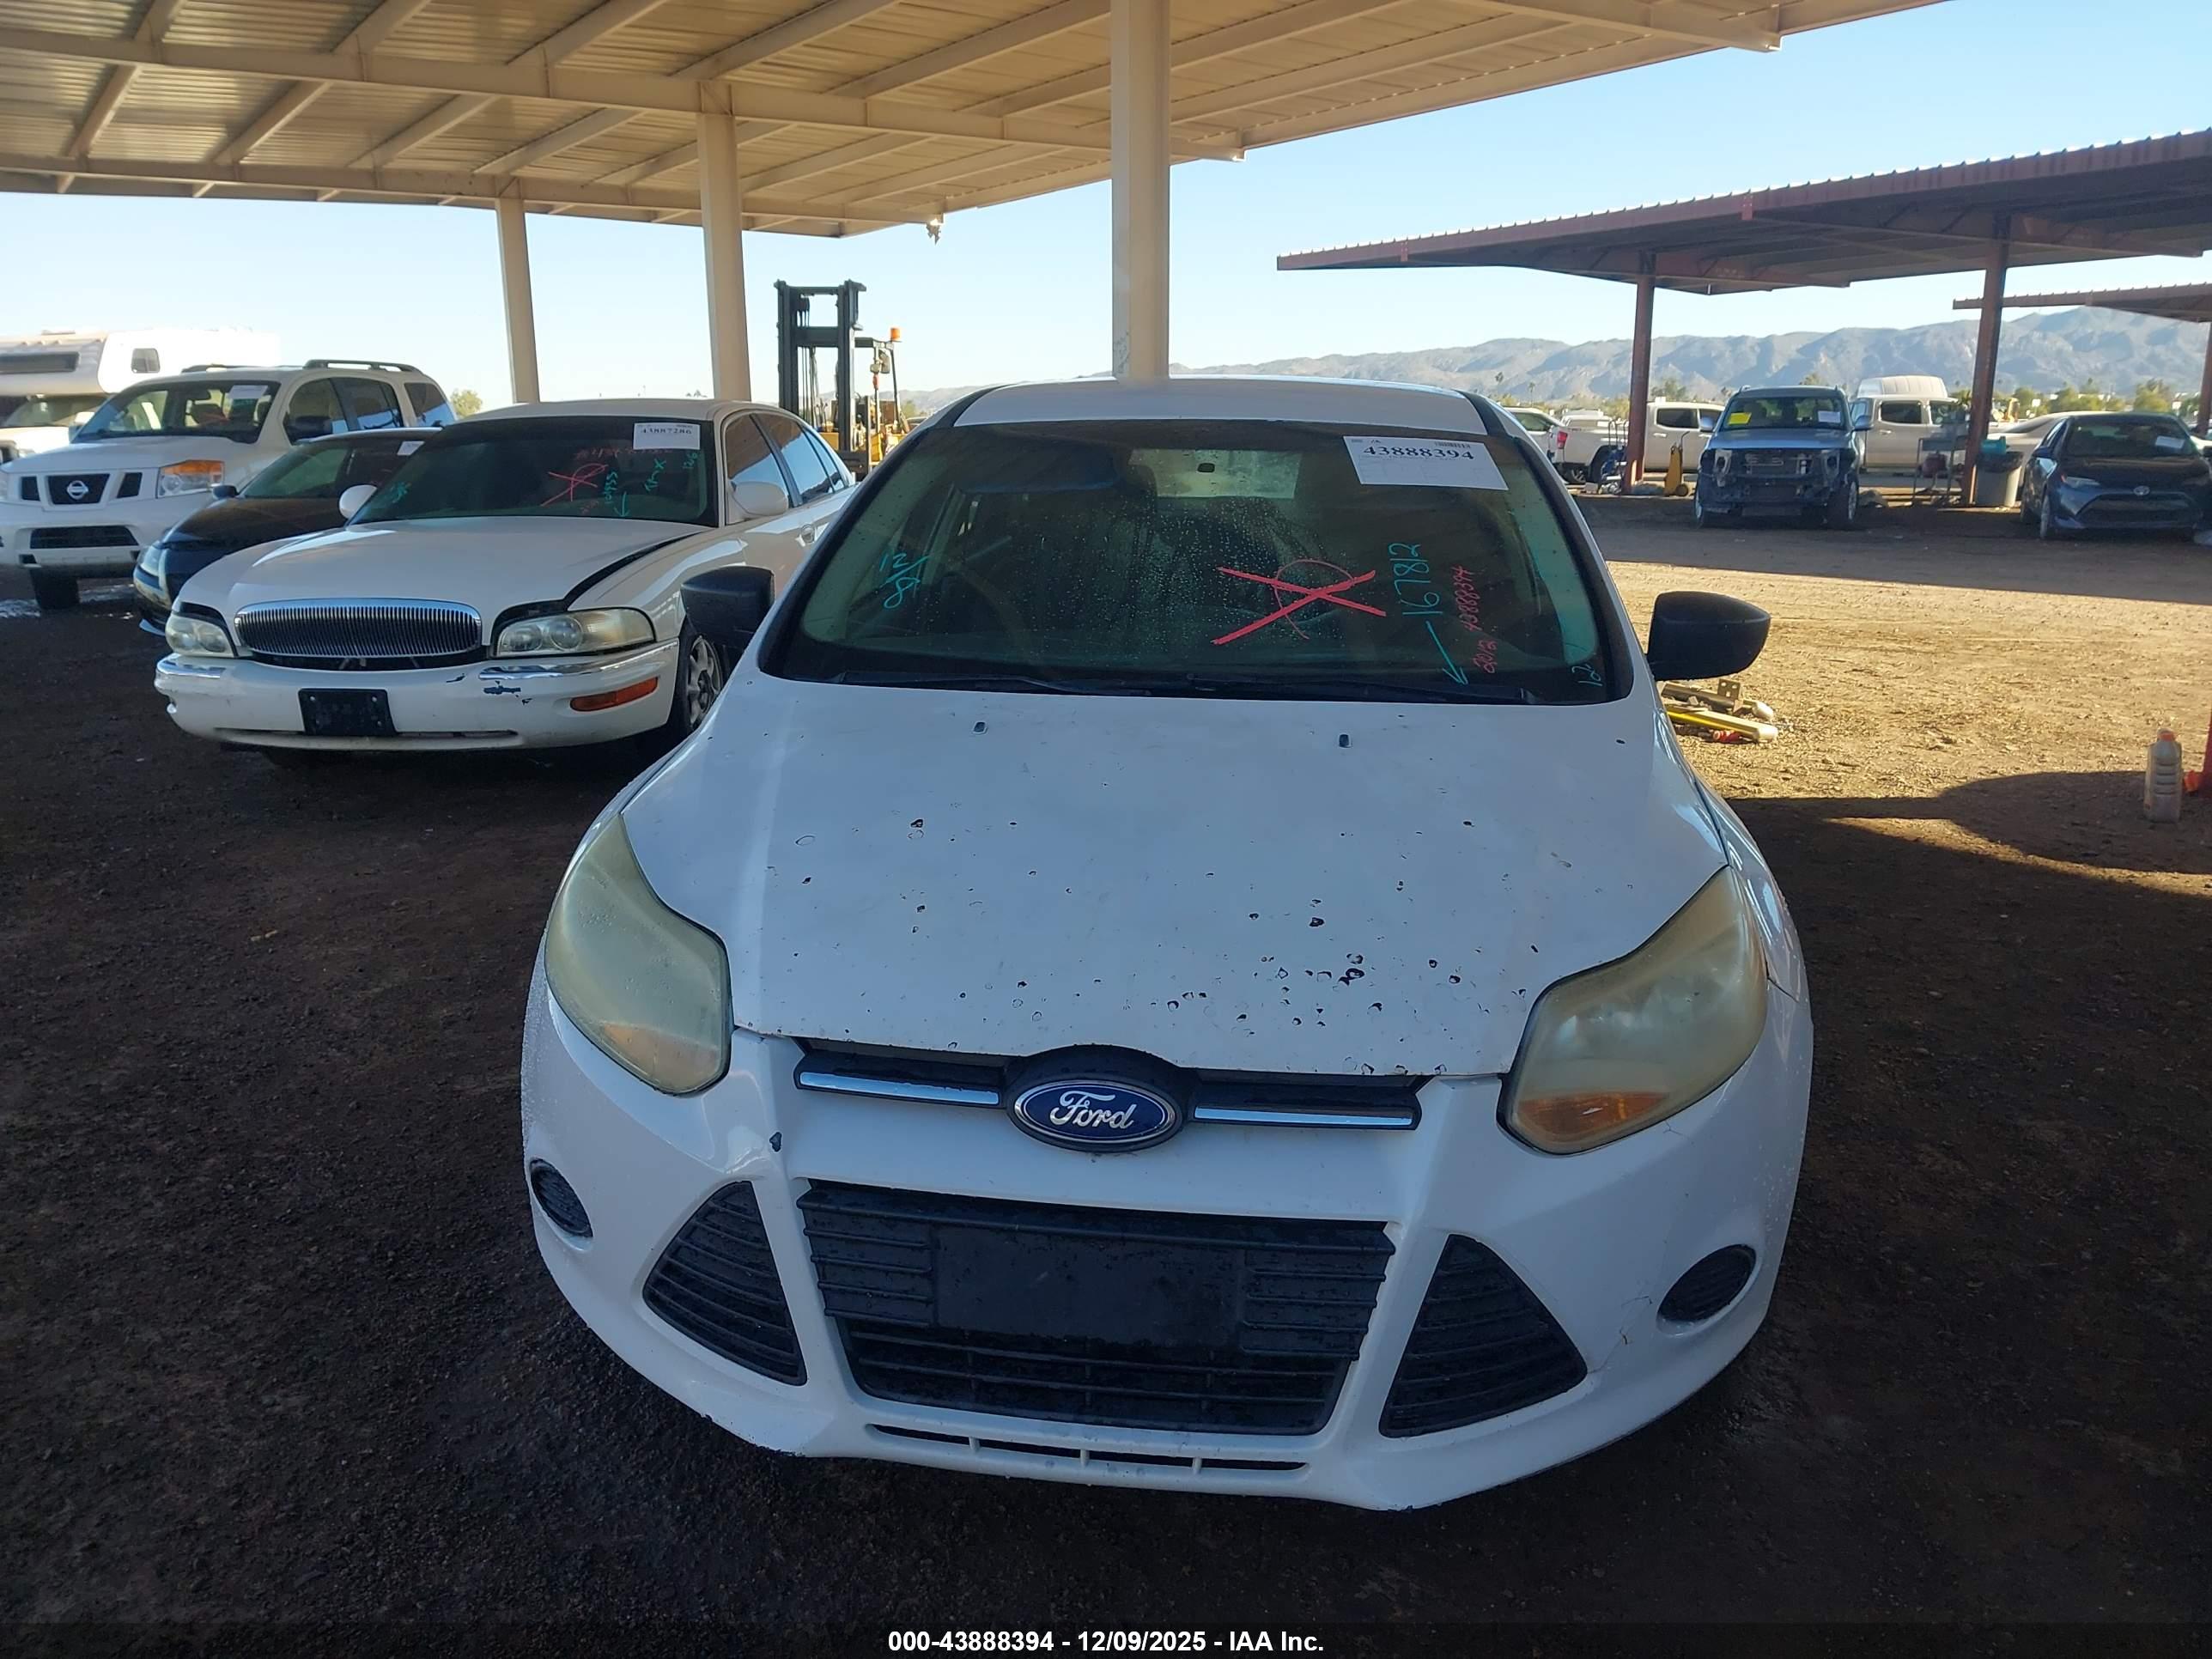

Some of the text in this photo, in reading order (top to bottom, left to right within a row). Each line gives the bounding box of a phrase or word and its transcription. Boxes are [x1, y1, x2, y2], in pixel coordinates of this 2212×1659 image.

[1363, 446, 1474, 460] 43888394
[1388, 543, 1443, 615] 167812
[1049, 1090, 1138, 1129] Ford
